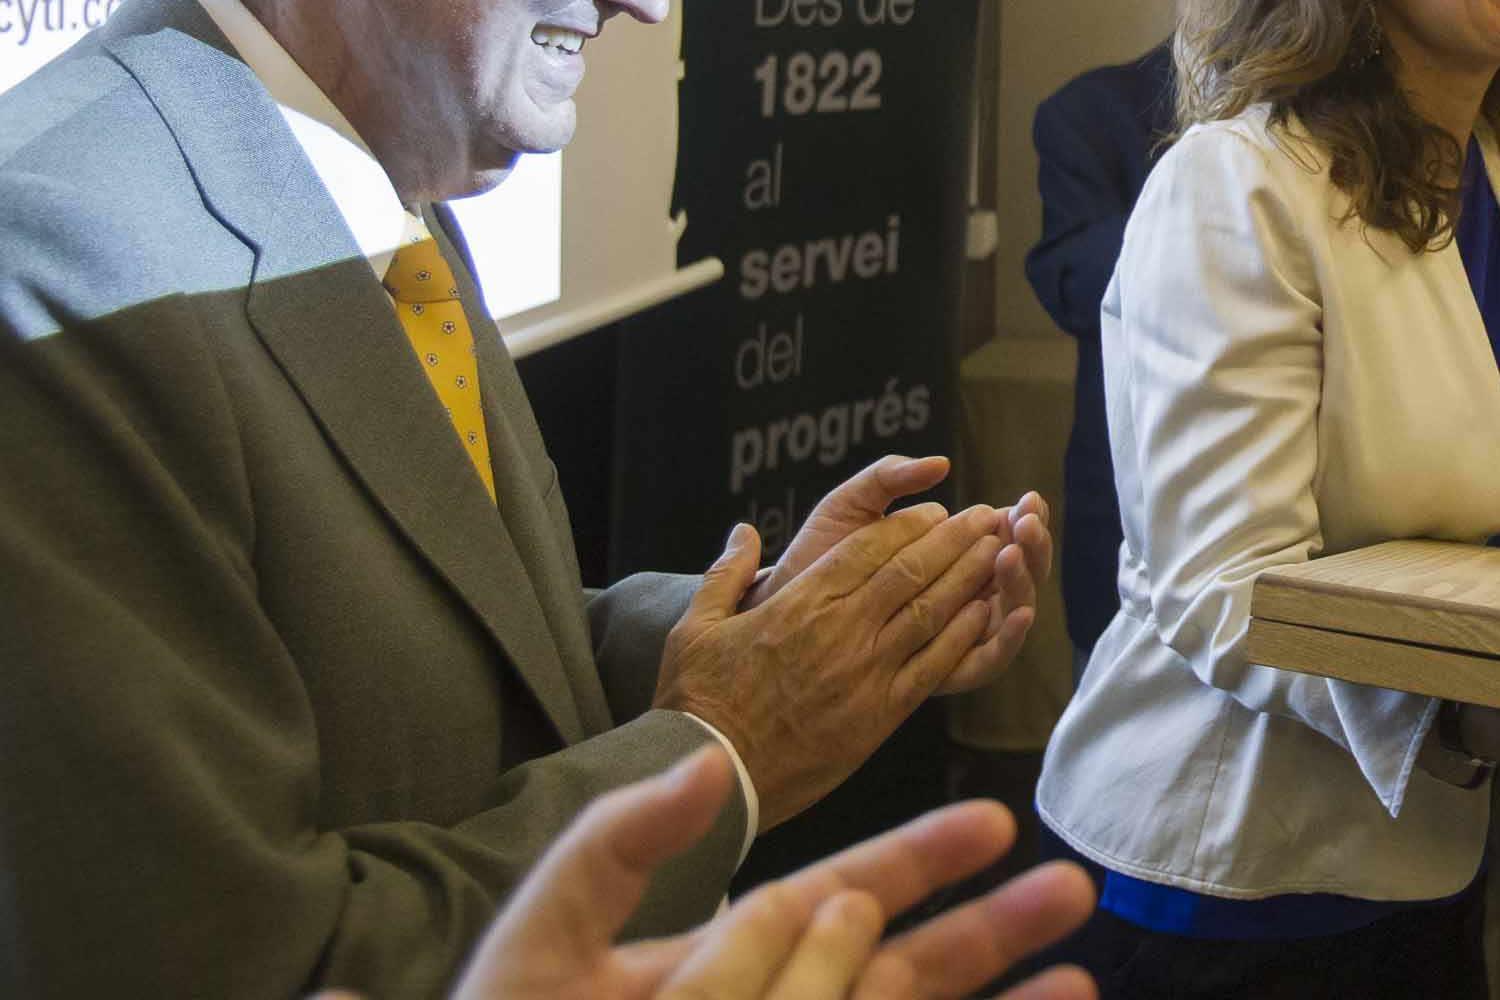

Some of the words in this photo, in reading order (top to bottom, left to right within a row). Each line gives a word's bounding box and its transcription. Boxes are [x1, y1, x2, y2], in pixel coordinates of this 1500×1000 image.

[753, 49, 884, 118] 1822
[743, 142, 784, 210] al
[739, 215, 902, 299] servei
[735, 314, 804, 390] del
[729, 376, 932, 495] progrés
